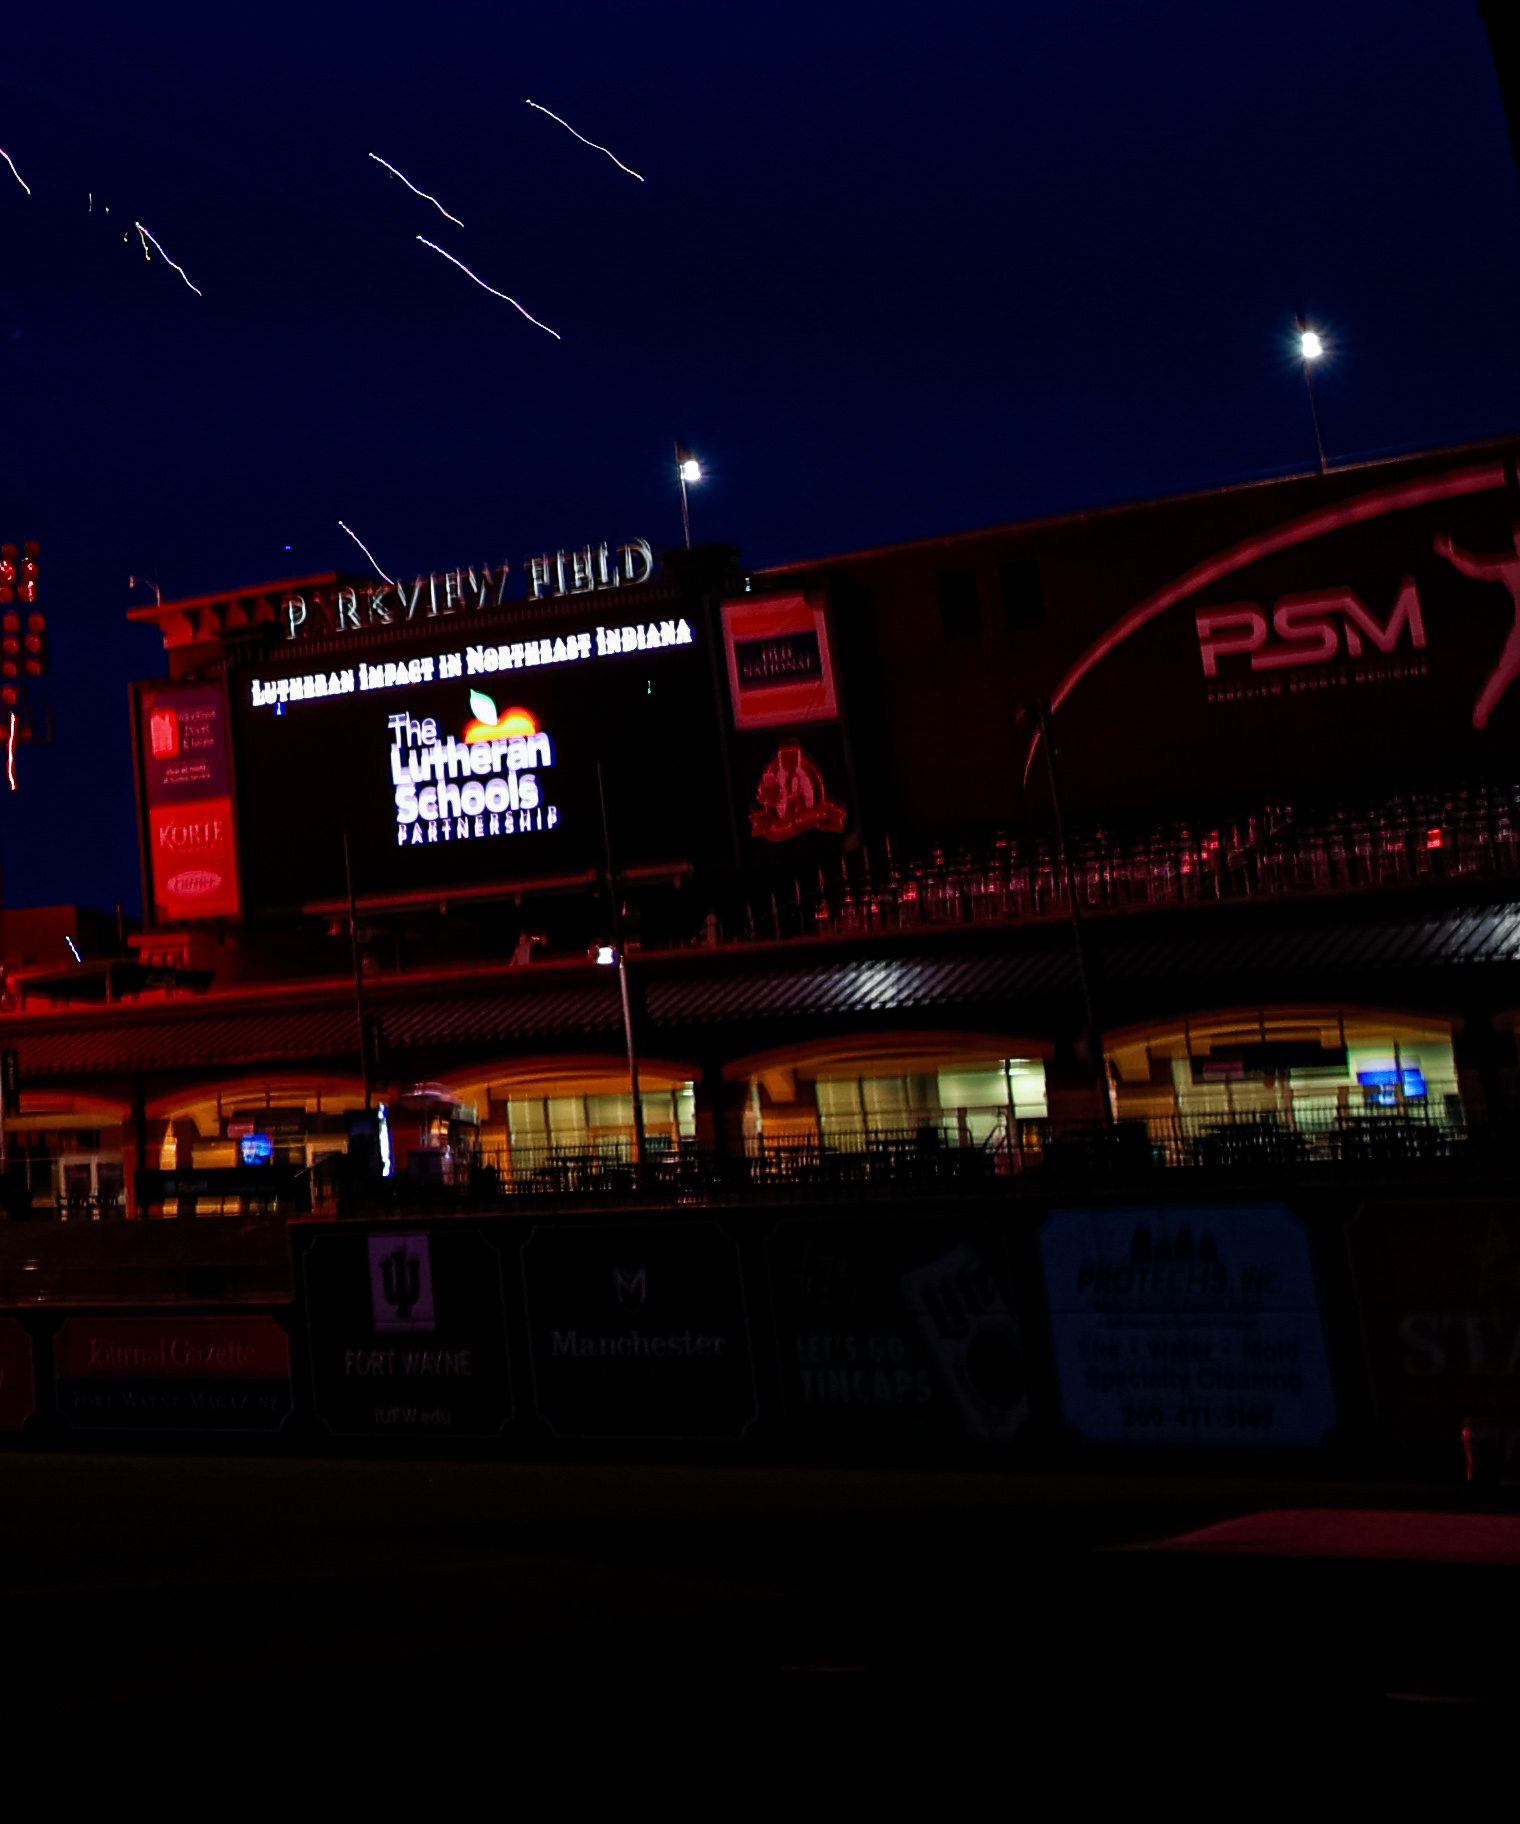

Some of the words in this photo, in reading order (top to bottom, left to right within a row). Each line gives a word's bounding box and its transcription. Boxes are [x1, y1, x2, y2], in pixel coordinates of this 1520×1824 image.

[528, 537, 653, 601] FIELD
[1196, 577, 1427, 677] PSM
[251, 669, 355, 707] LUTHERAN
[359, 657, 435, 691] IMPACT
[439, 653, 463, 679] IN
[466, 633, 592, 675] NORTHEAST
[596, 618, 693, 656] INDIANA
[743, 654, 813, 679] NATIONAL
[388, 711, 437, 749] The
[391, 732, 552, 785] Lutheran
[395, 770, 540, 824] Schools
[158, 821, 224, 853] KORTE
[398, 806, 558, 846] PARTNERSHIP
[344, 1347, 397, 1376] FORT
[400, 1347, 473, 1376] WAYNE
[549, 1327, 728, 1358] Manchester
[868, 1328, 906, 1362] GO
[799, 1369, 933, 1405] TINCAPS
